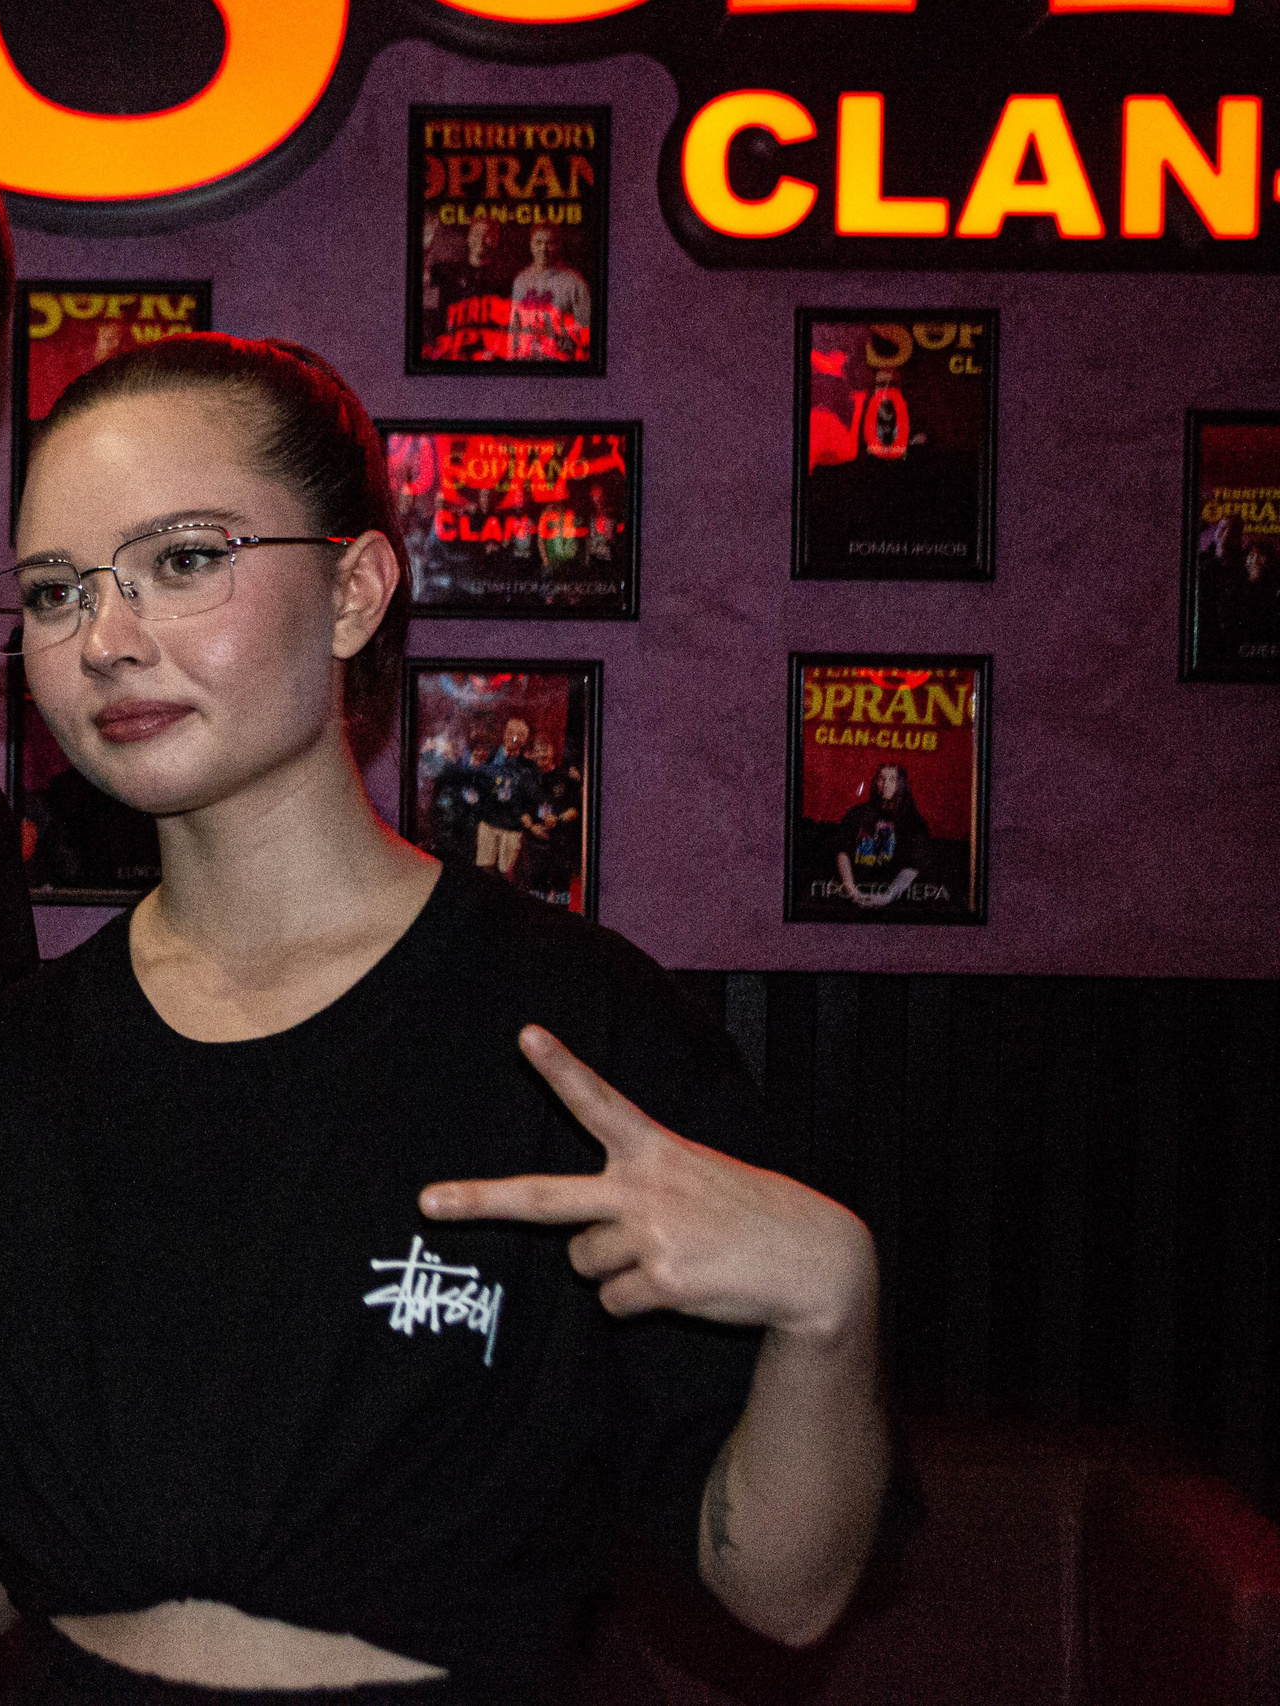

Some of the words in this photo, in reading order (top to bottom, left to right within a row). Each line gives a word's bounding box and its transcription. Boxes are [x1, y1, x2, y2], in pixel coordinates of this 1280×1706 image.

[681, 88, 1280, 239] CLAN
[439, 203, 583, 225] CLAN-CLUB
[803, 682, 975, 727] OPRAN
[815, 725, 938, 751] CLAN-CLUB
